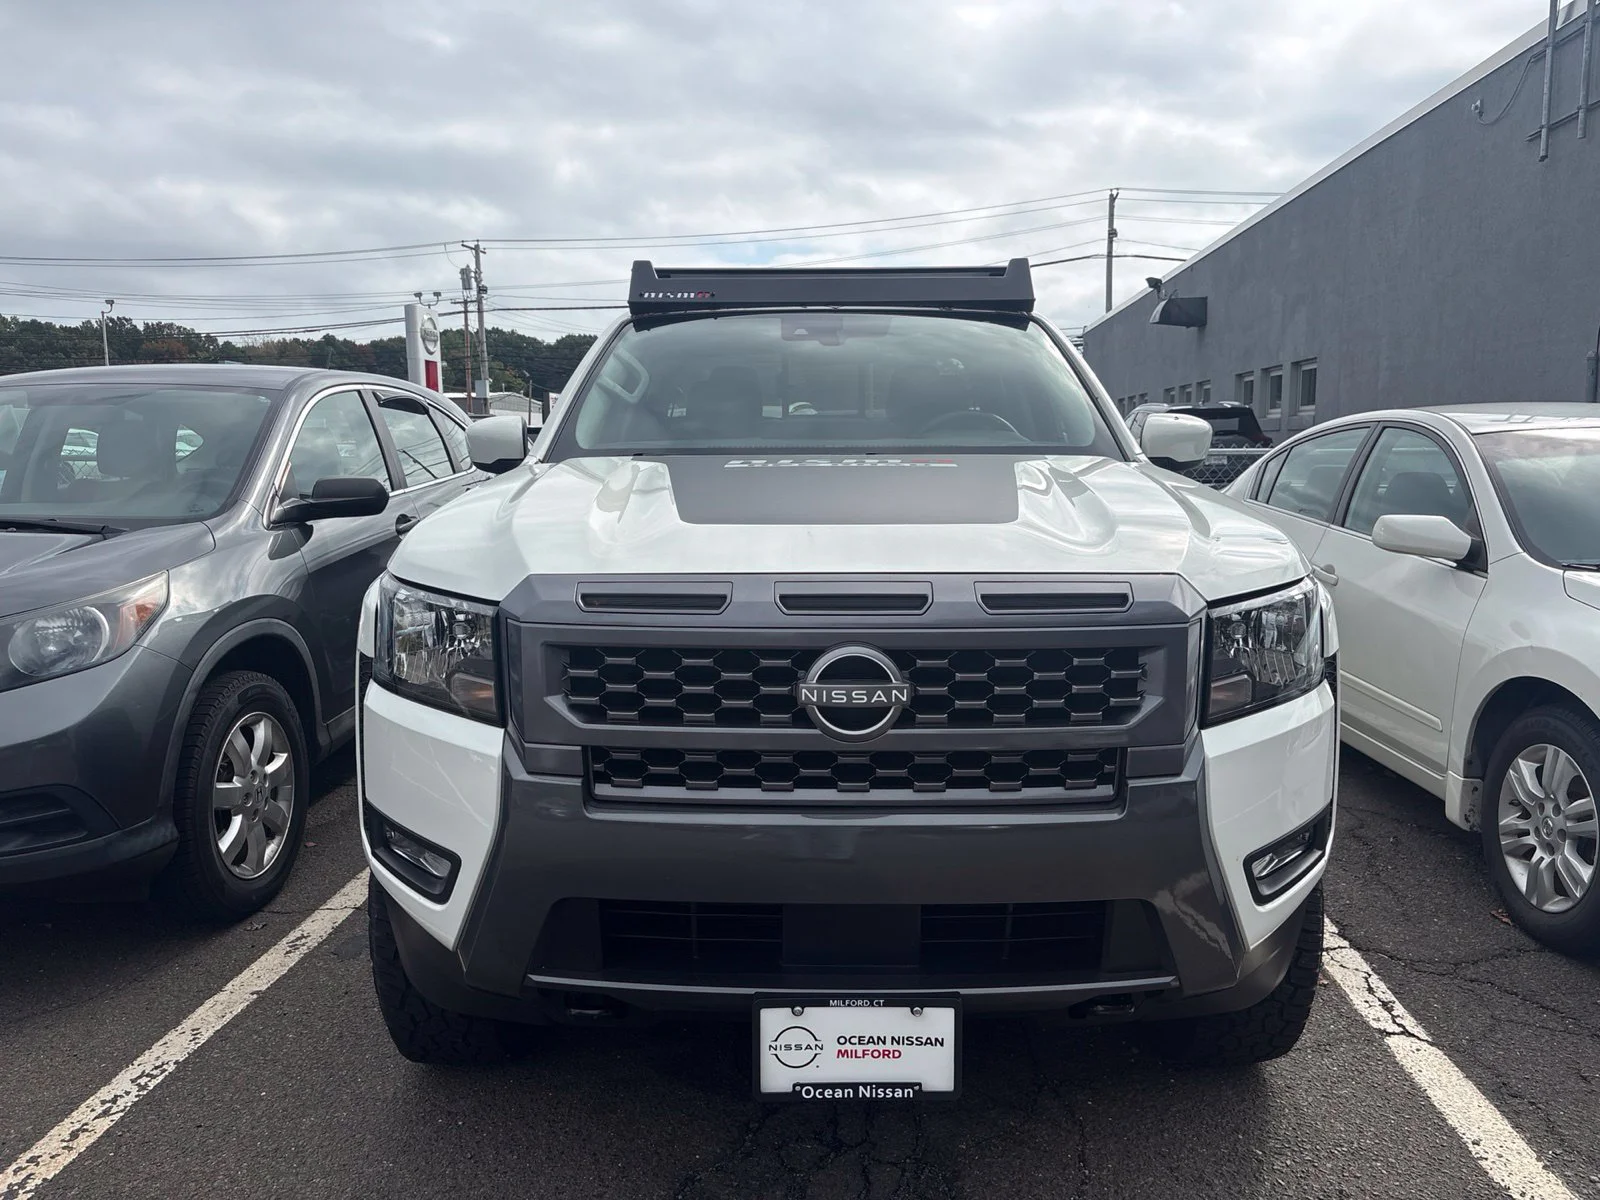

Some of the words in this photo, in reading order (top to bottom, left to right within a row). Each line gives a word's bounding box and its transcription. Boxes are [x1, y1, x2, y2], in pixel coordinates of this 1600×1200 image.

[801, 688, 907, 703] NISSAN
[873, 999, 885, 1007] CT
[836, 1035, 887, 1046] OCEAN
[890, 1037, 945, 1048] NISSAN
[768, 1043, 824, 1052] NISSAN
[836, 1049, 902, 1059] MILFORD
[801, 1085, 853, 1099] Ocean
[858, 1085, 914, 1098] Nissan
